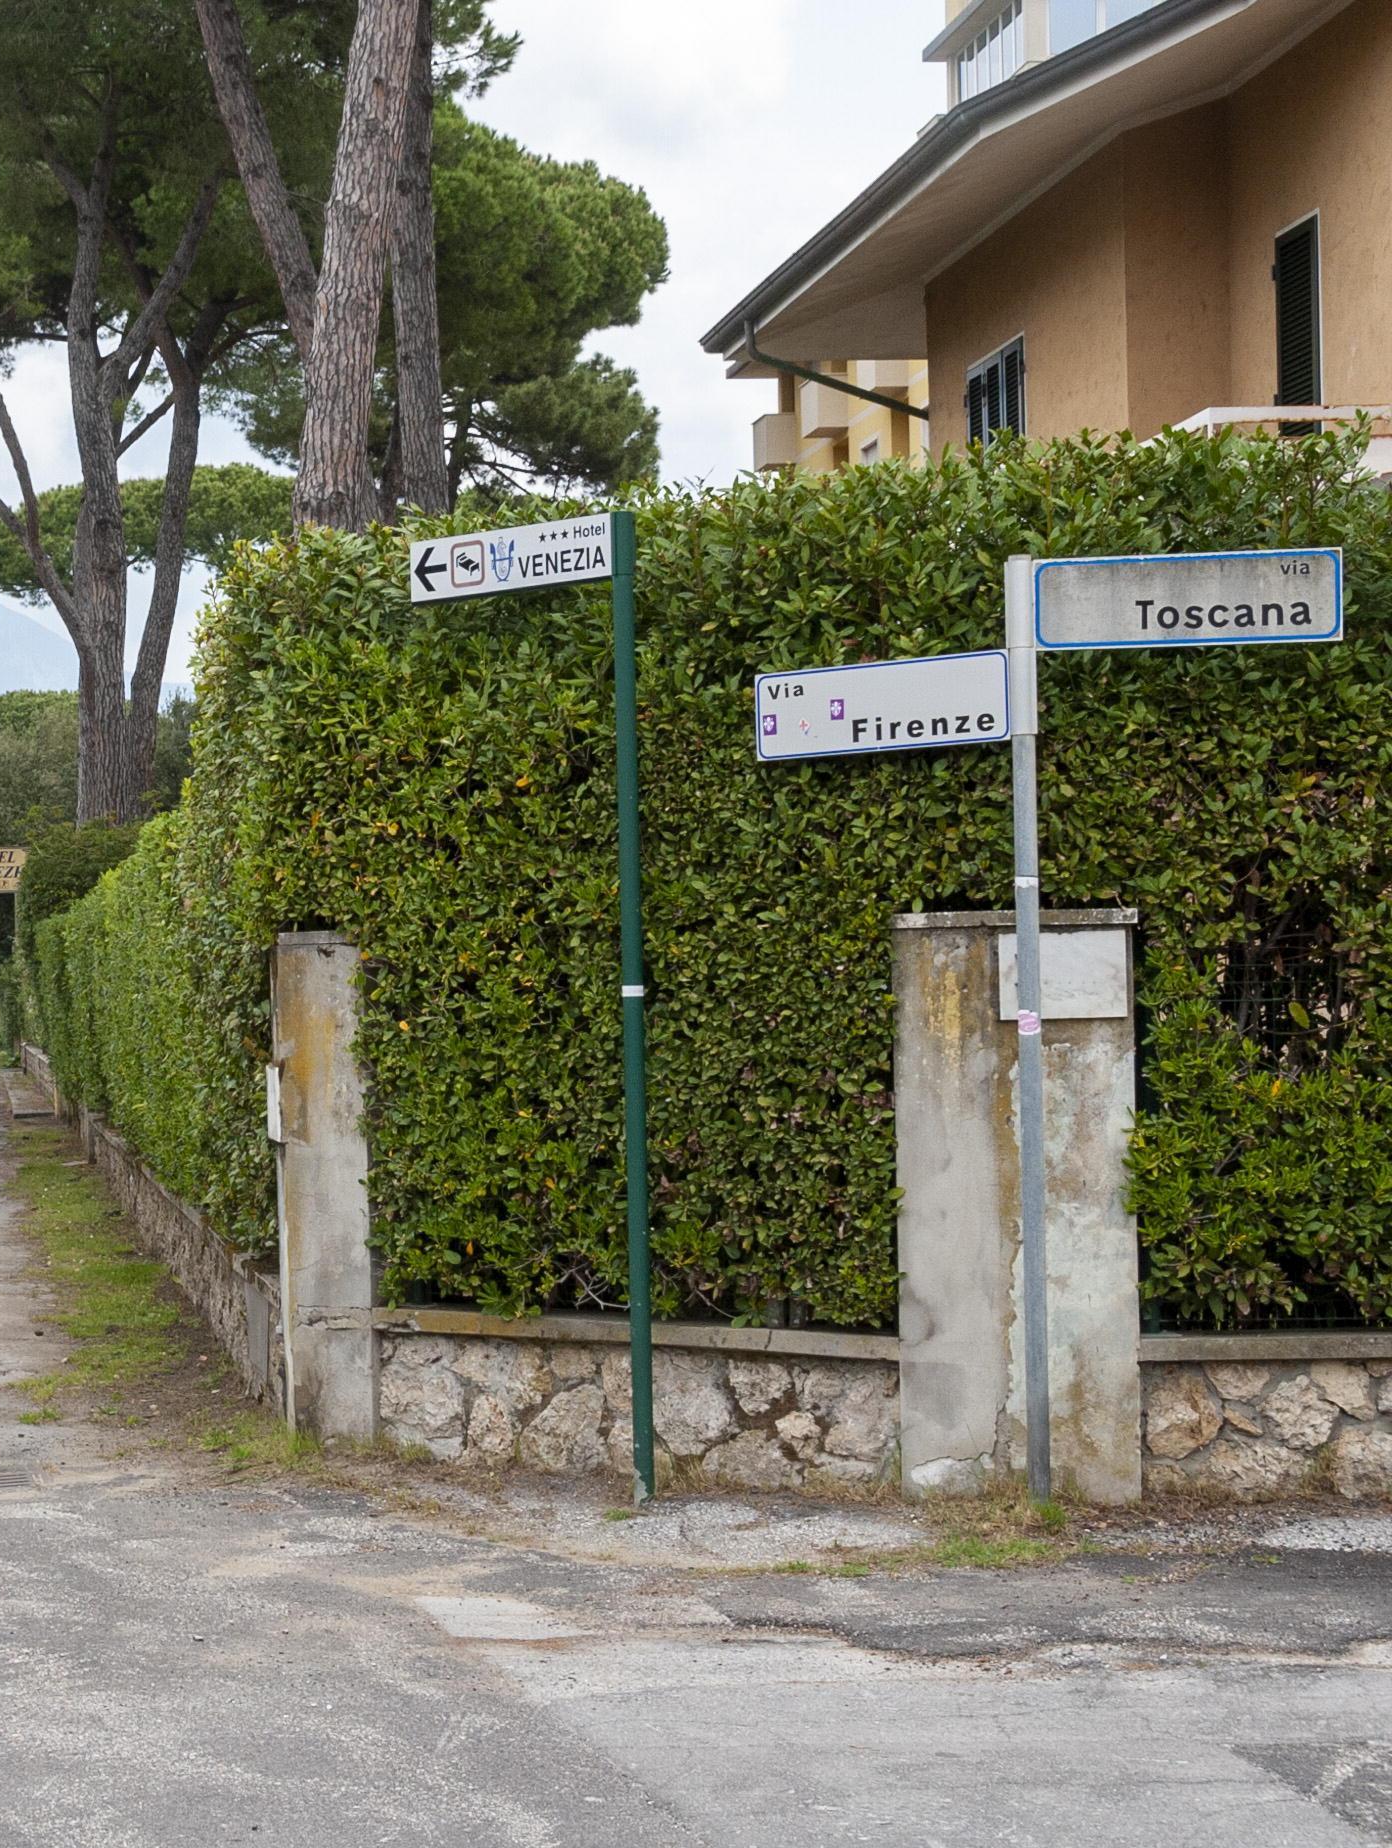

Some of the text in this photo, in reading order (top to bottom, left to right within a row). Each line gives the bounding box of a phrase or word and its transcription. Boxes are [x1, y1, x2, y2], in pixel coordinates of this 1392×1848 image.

[573, 522, 606, 540] Hotel
[518, 546, 606, 578] VENEZIA
[1280, 560, 1311, 575] via
[1135, 600, 1312, 630] Toscana
[767, 683, 804, 700] Via
[852, 713, 995, 743] Firenze
